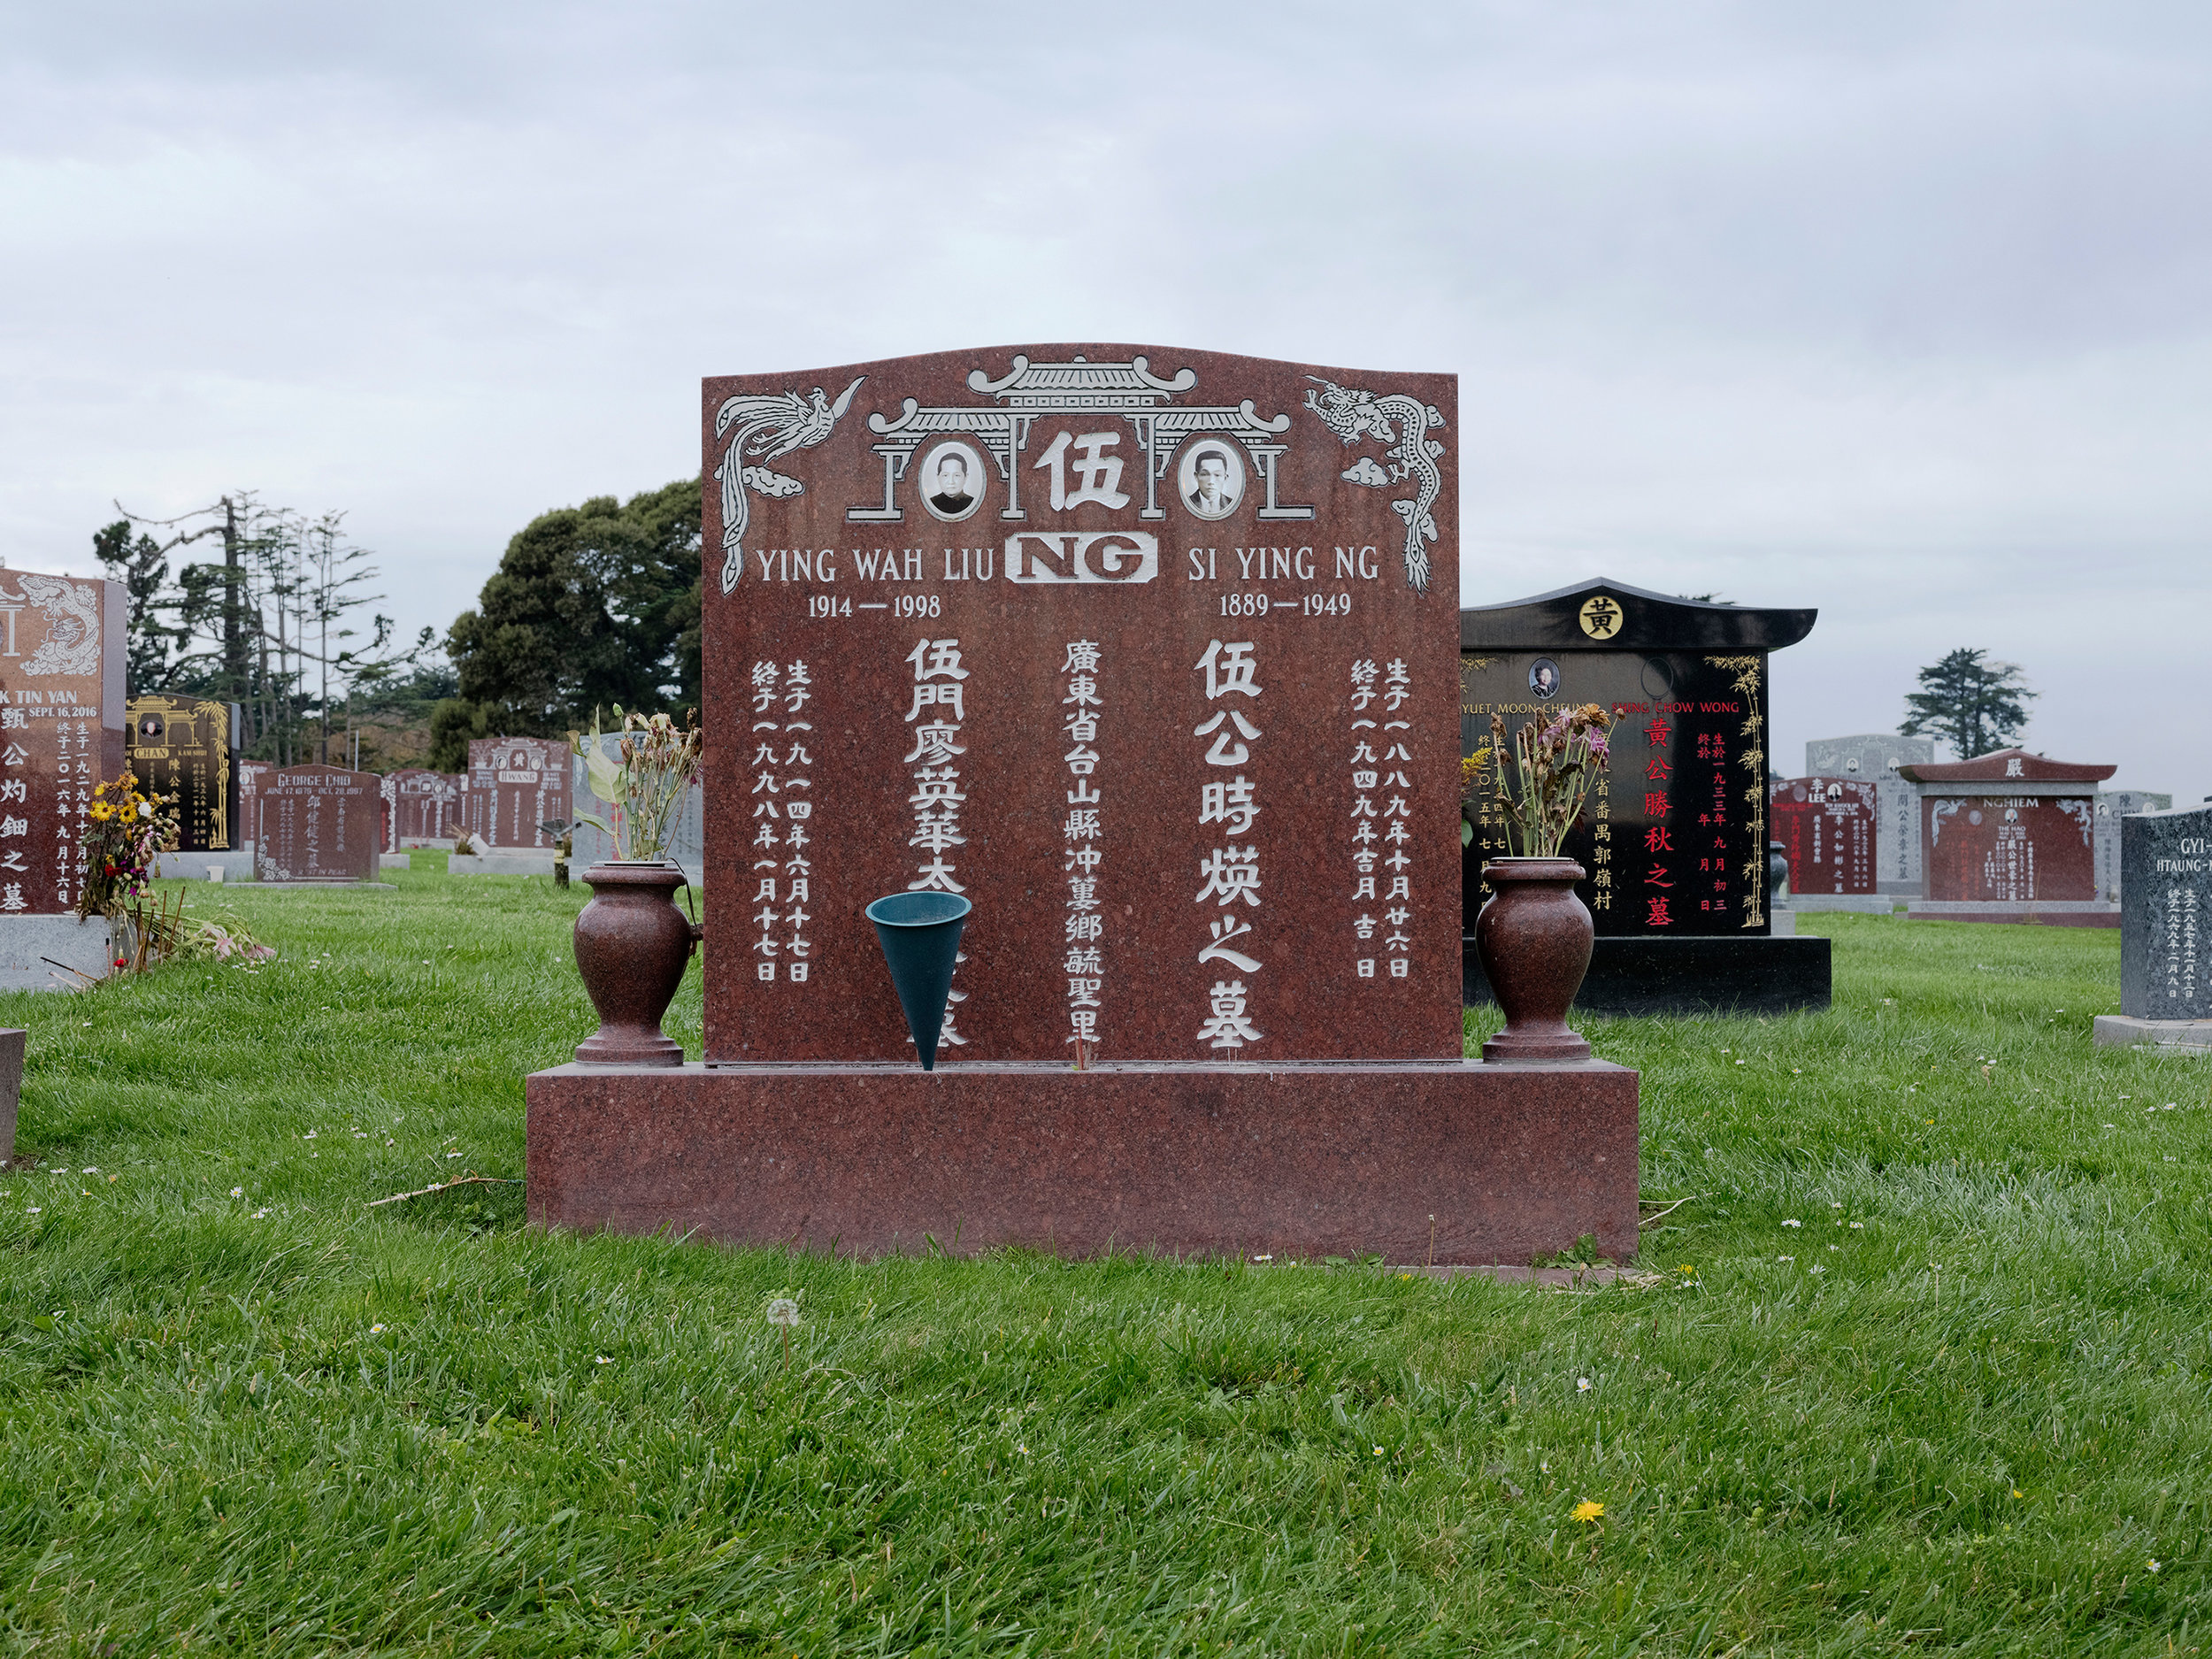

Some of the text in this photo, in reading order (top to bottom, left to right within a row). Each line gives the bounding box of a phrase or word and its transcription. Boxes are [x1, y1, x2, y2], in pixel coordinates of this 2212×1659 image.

[1033, 430, 1130, 511] 伍
[1018, 535, 1144, 580] NG
[756, 549, 995, 582] YING WAH LIU
[1188, 546, 1379, 581] SI YING NG
[15, 691, 42, 703] TIN
[48, 691, 77, 703] YAN
[29, 707, 55, 718] SEPT.
[1462, 703, 1492, 714] YUET
[1497, 703, 1536, 714] MOON
[1612, 703, 1739, 714] SHING CHOW WONG
[136, 749, 167, 758] CHAN
[278, 773, 321, 787] GEORGE
[1809, 794, 1826, 803] LEE
[1983, 798, 2039, 808] NGHIEM
